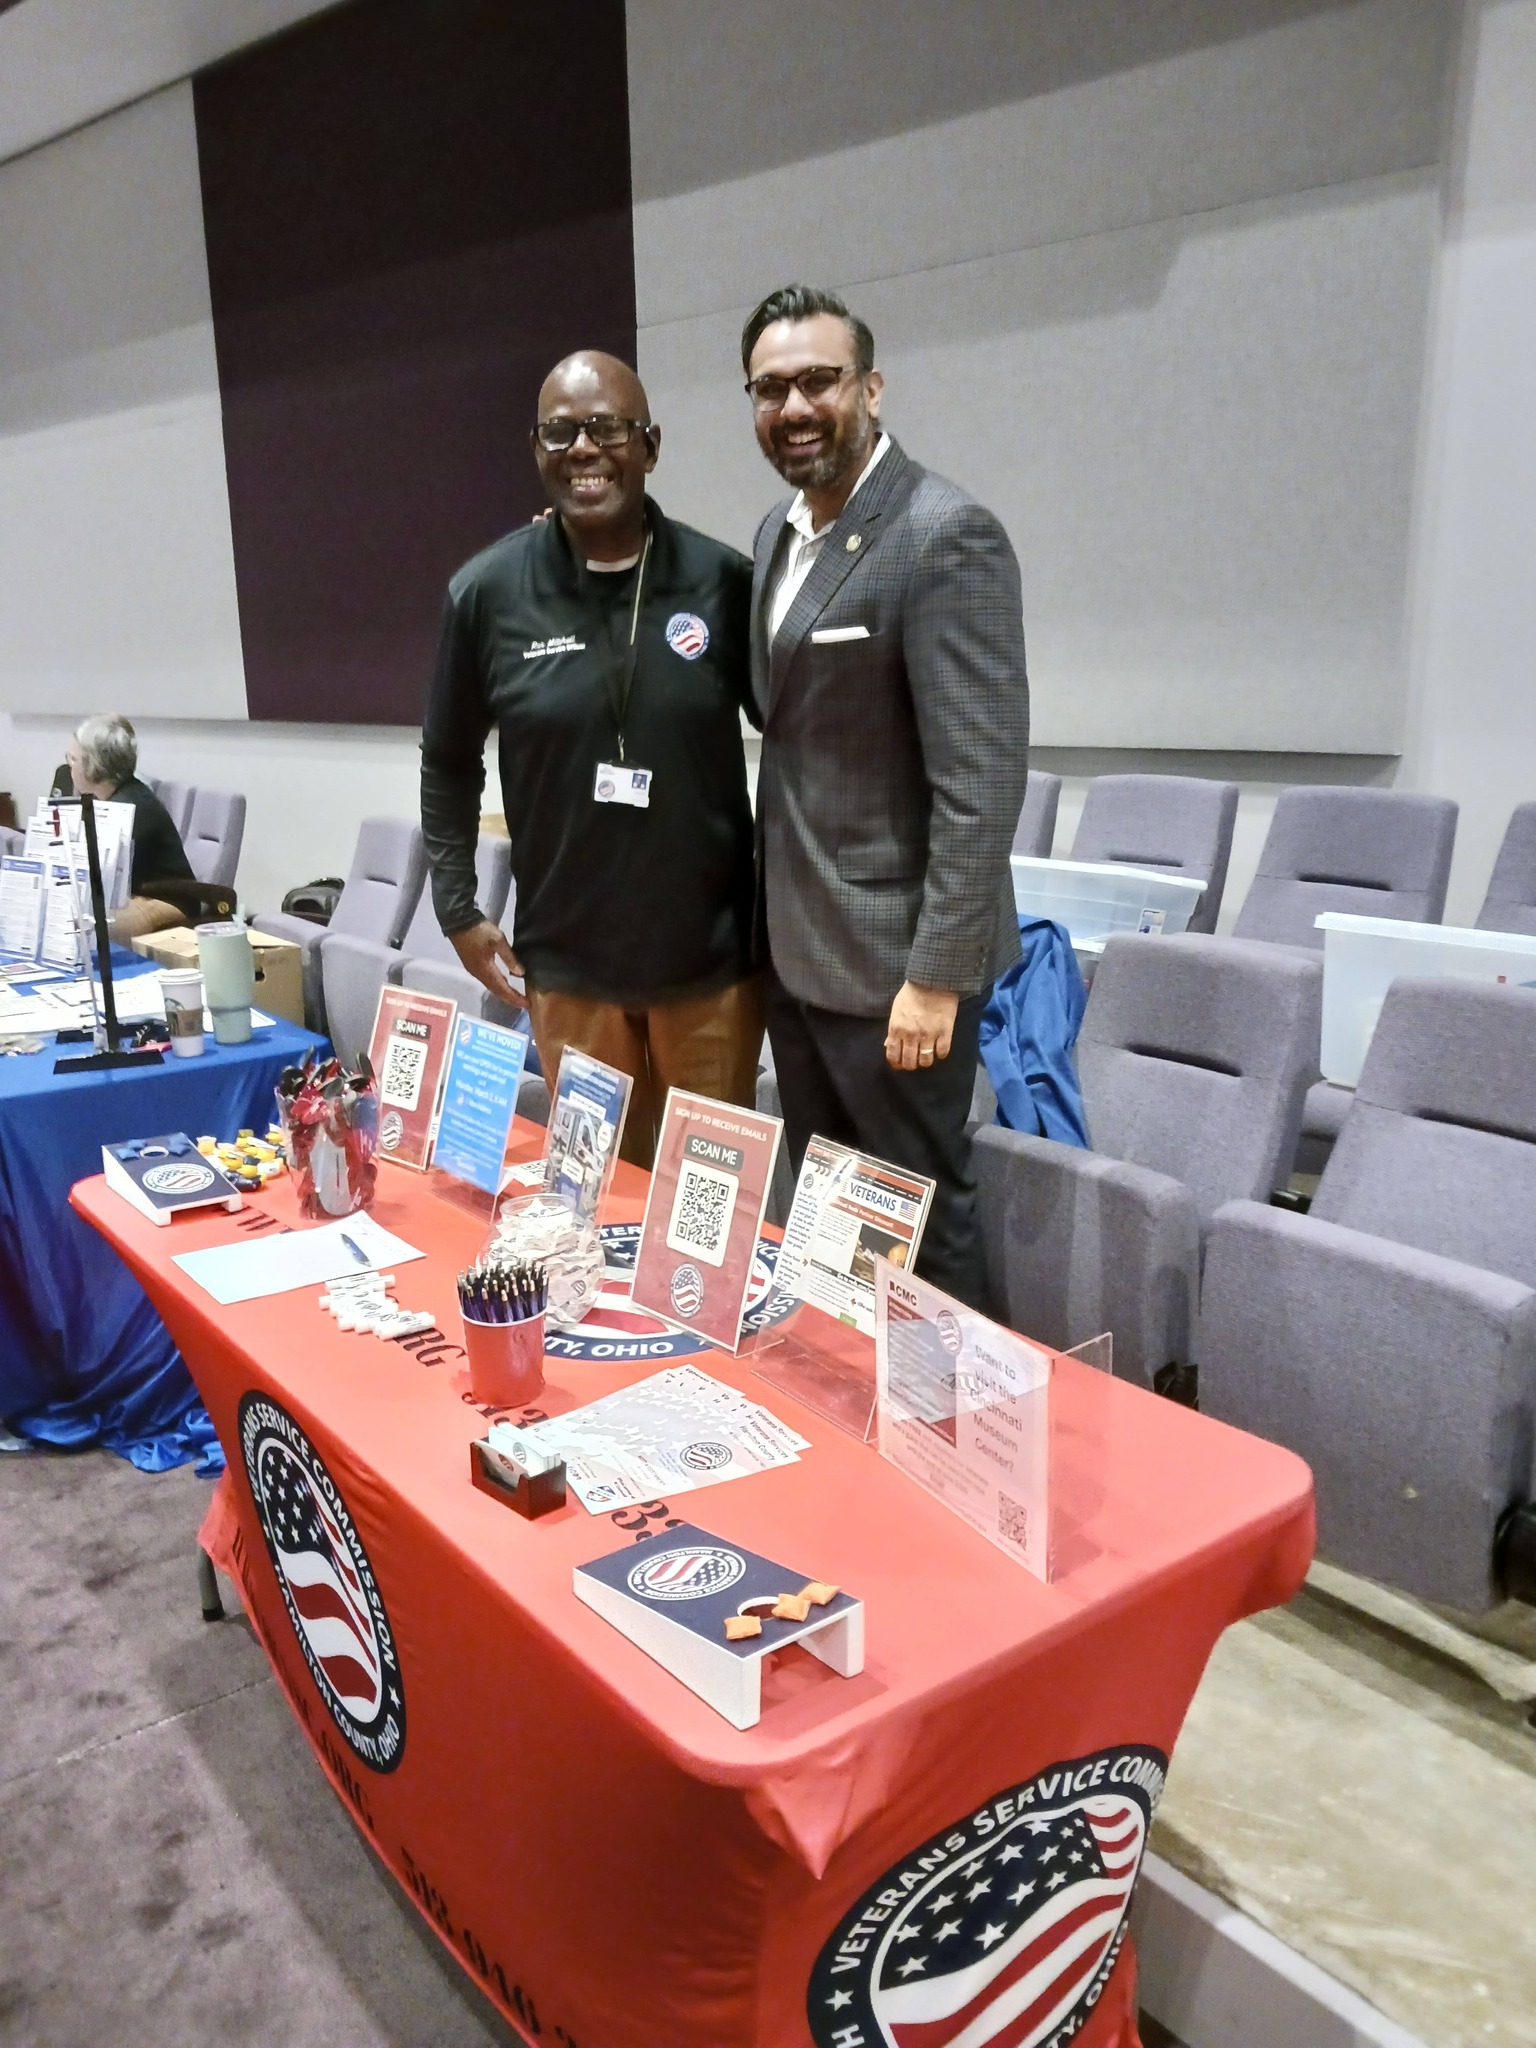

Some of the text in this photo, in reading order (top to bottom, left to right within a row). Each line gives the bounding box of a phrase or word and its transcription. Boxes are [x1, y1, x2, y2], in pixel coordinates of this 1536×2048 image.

[396, 1019, 428, 1037] SCAN ME
[675, 1106, 767, 1142] SIGN UP TO RECEIVE EMAILS
[691, 1138, 738, 1166] SCAN ME
[850, 1182, 897, 1211] VETERANS
[894, 1285, 917, 1306] CMC
[591, 1341, 674, 1359] OHIO
[975, 1345, 1016, 1380] Want to
[970, 1388, 1023, 1431] Cincinnati
[998, 1384, 1017, 1404] the
[974, 1413, 1018, 1452] Museum
[975, 1437, 1014, 1472] Center?
[255, 1402, 310, 1463] SERVICE
[312, 1458, 397, 1671] COMMISSION
[274, 1564, 332, 1707] HAMILTON
[333, 1703, 384, 1766] COUNTY,
[378, 1713, 400, 1761] OHIO
[830, 1831, 967, 1974] VETERANS
[973, 1759, 1109, 1836] SERVICE
